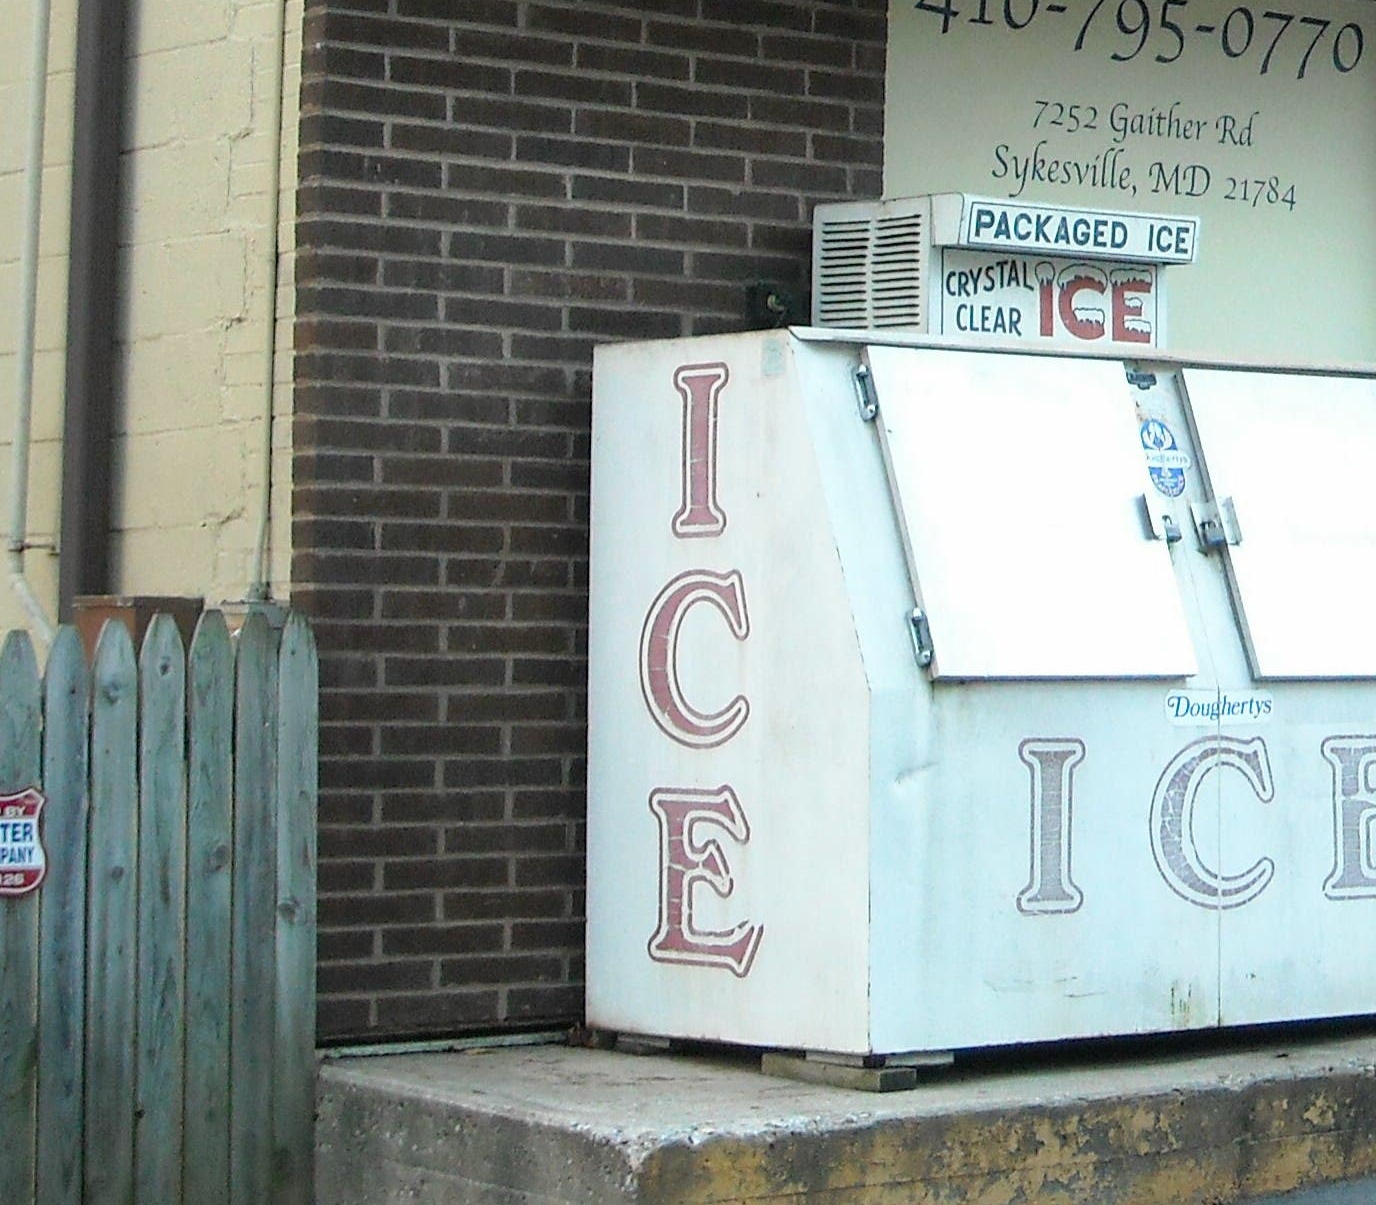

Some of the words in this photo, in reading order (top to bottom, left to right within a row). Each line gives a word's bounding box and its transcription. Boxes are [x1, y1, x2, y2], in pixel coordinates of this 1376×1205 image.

[1032, 100, 1098, 132] 7252
[1109, 101, 1206, 143] Gaither
[1215, 112, 1259, 147] Rd
[991, 140, 1138, 196] Sykesville,
[1149, 162, 1212, 197] MD
[1223, 176, 1297, 210] 21784
[974, 209, 1128, 249] PACKAGED
[1147, 224, 1190, 254] ICE
[945, 260, 1035, 297] CRYSTAL
[1034, 260, 1153, 343] ICE
[955, 303, 1022, 336] CLEAR
[638, 361, 764, 979] ICE
[1167, 695, 1272, 720] Doughertys
